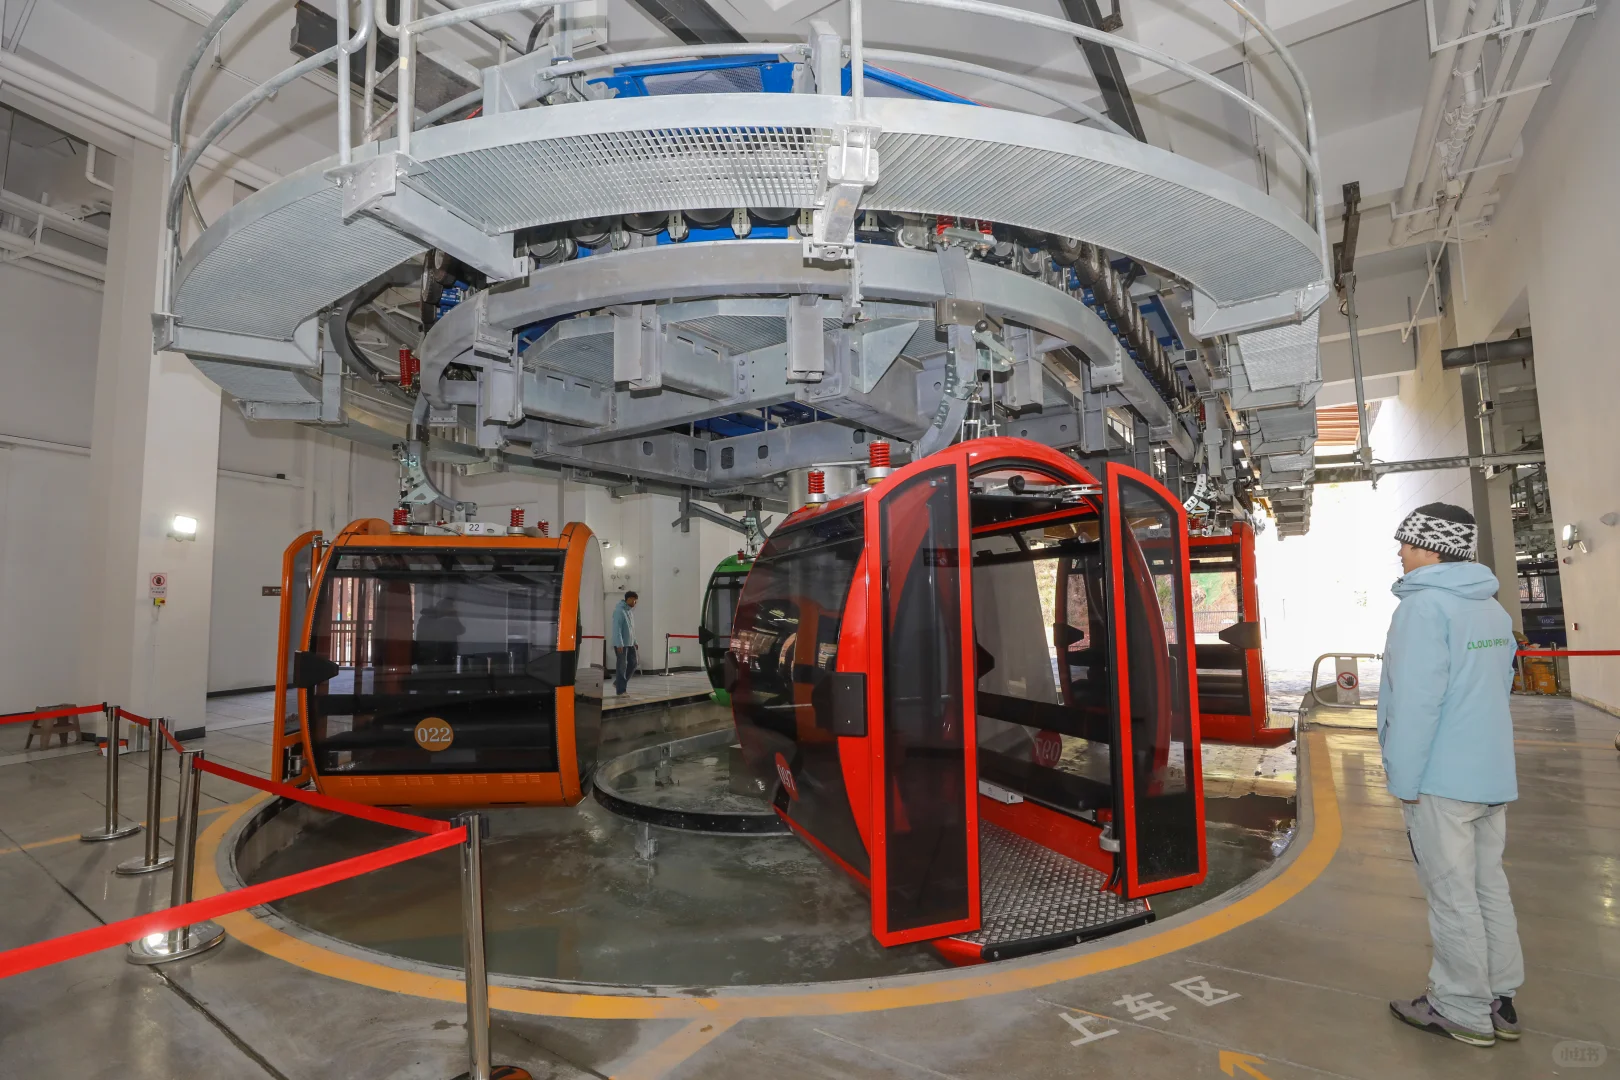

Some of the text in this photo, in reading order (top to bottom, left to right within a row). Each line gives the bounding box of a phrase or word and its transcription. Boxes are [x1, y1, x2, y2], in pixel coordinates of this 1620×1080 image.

[469, 523, 480, 532] 22
[417, 727, 451, 743] 022
[1058, 975, 1242, 1047] 上车区
